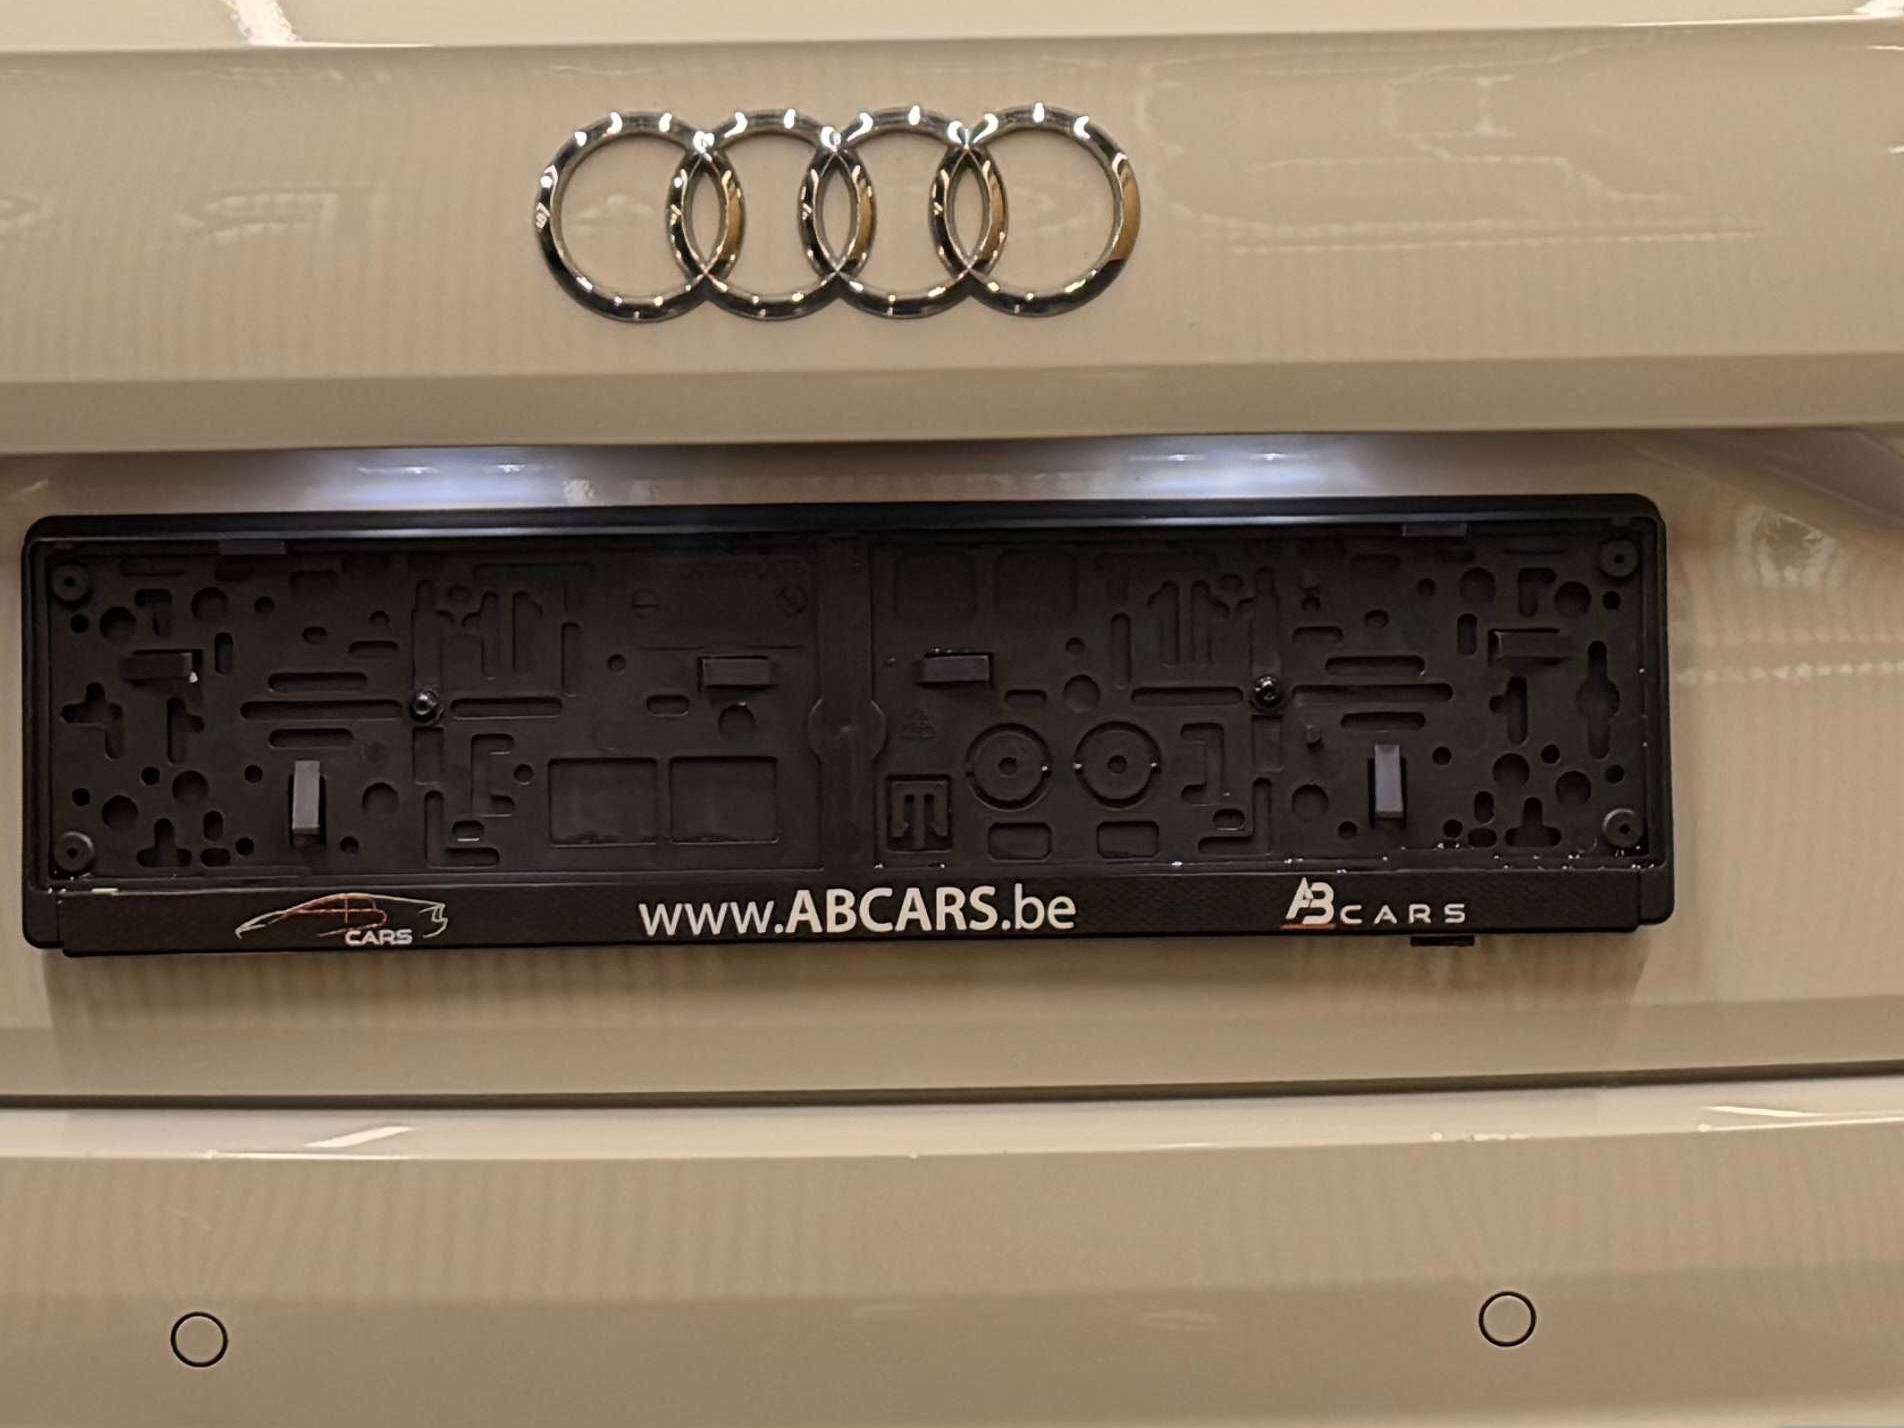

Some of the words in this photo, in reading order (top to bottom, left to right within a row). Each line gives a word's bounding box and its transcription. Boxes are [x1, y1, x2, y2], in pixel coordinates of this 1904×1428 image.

[638, 883, 1077, 936] www.ABCARS.be
[1340, 903, 1467, 924] CARS
[345, 929, 413, 946] CARS
